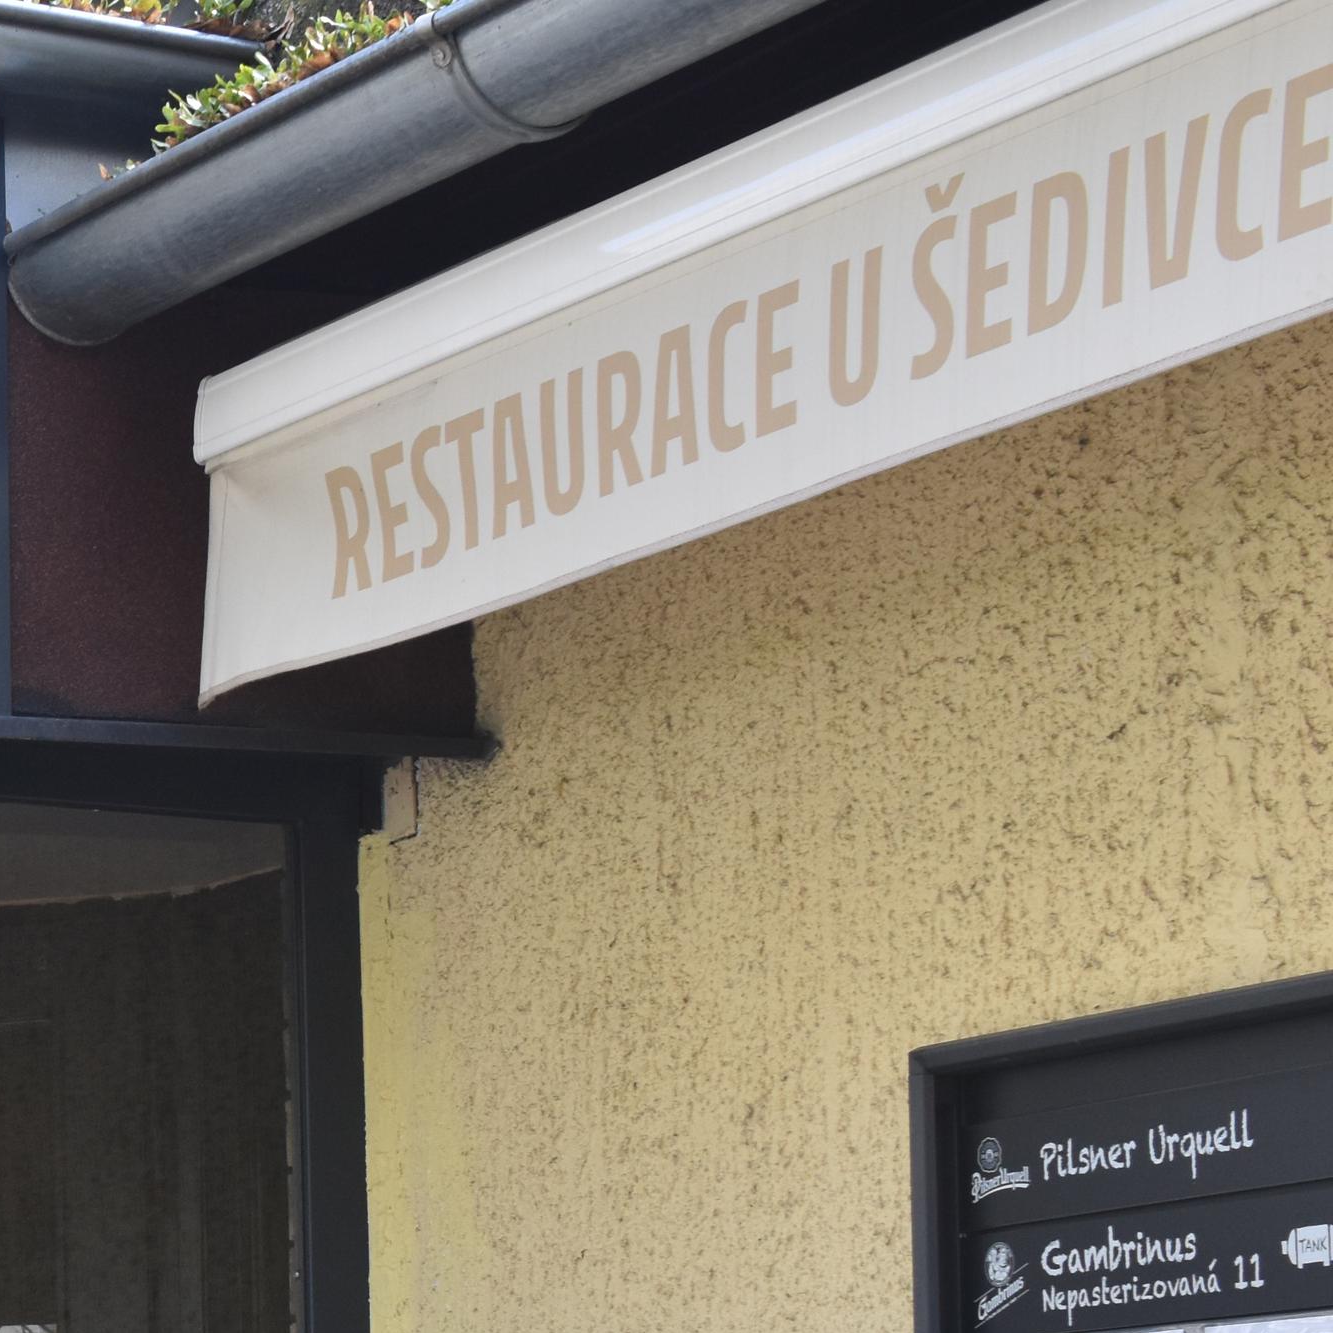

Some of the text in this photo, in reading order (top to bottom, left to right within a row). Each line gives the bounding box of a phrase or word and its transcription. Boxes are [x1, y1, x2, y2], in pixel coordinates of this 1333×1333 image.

[324, 63, 1333, 600] RESTAURACE U ŠEDIVCE
[1040, 1108, 1254, 1181] Pilsner Urquell
[1040, 1226, 1197, 1277] Gambrinus
[1299, 1236, 1327, 1253] TANK
[1042, 1252, 1265, 1326] Nepasterizovaná 11
